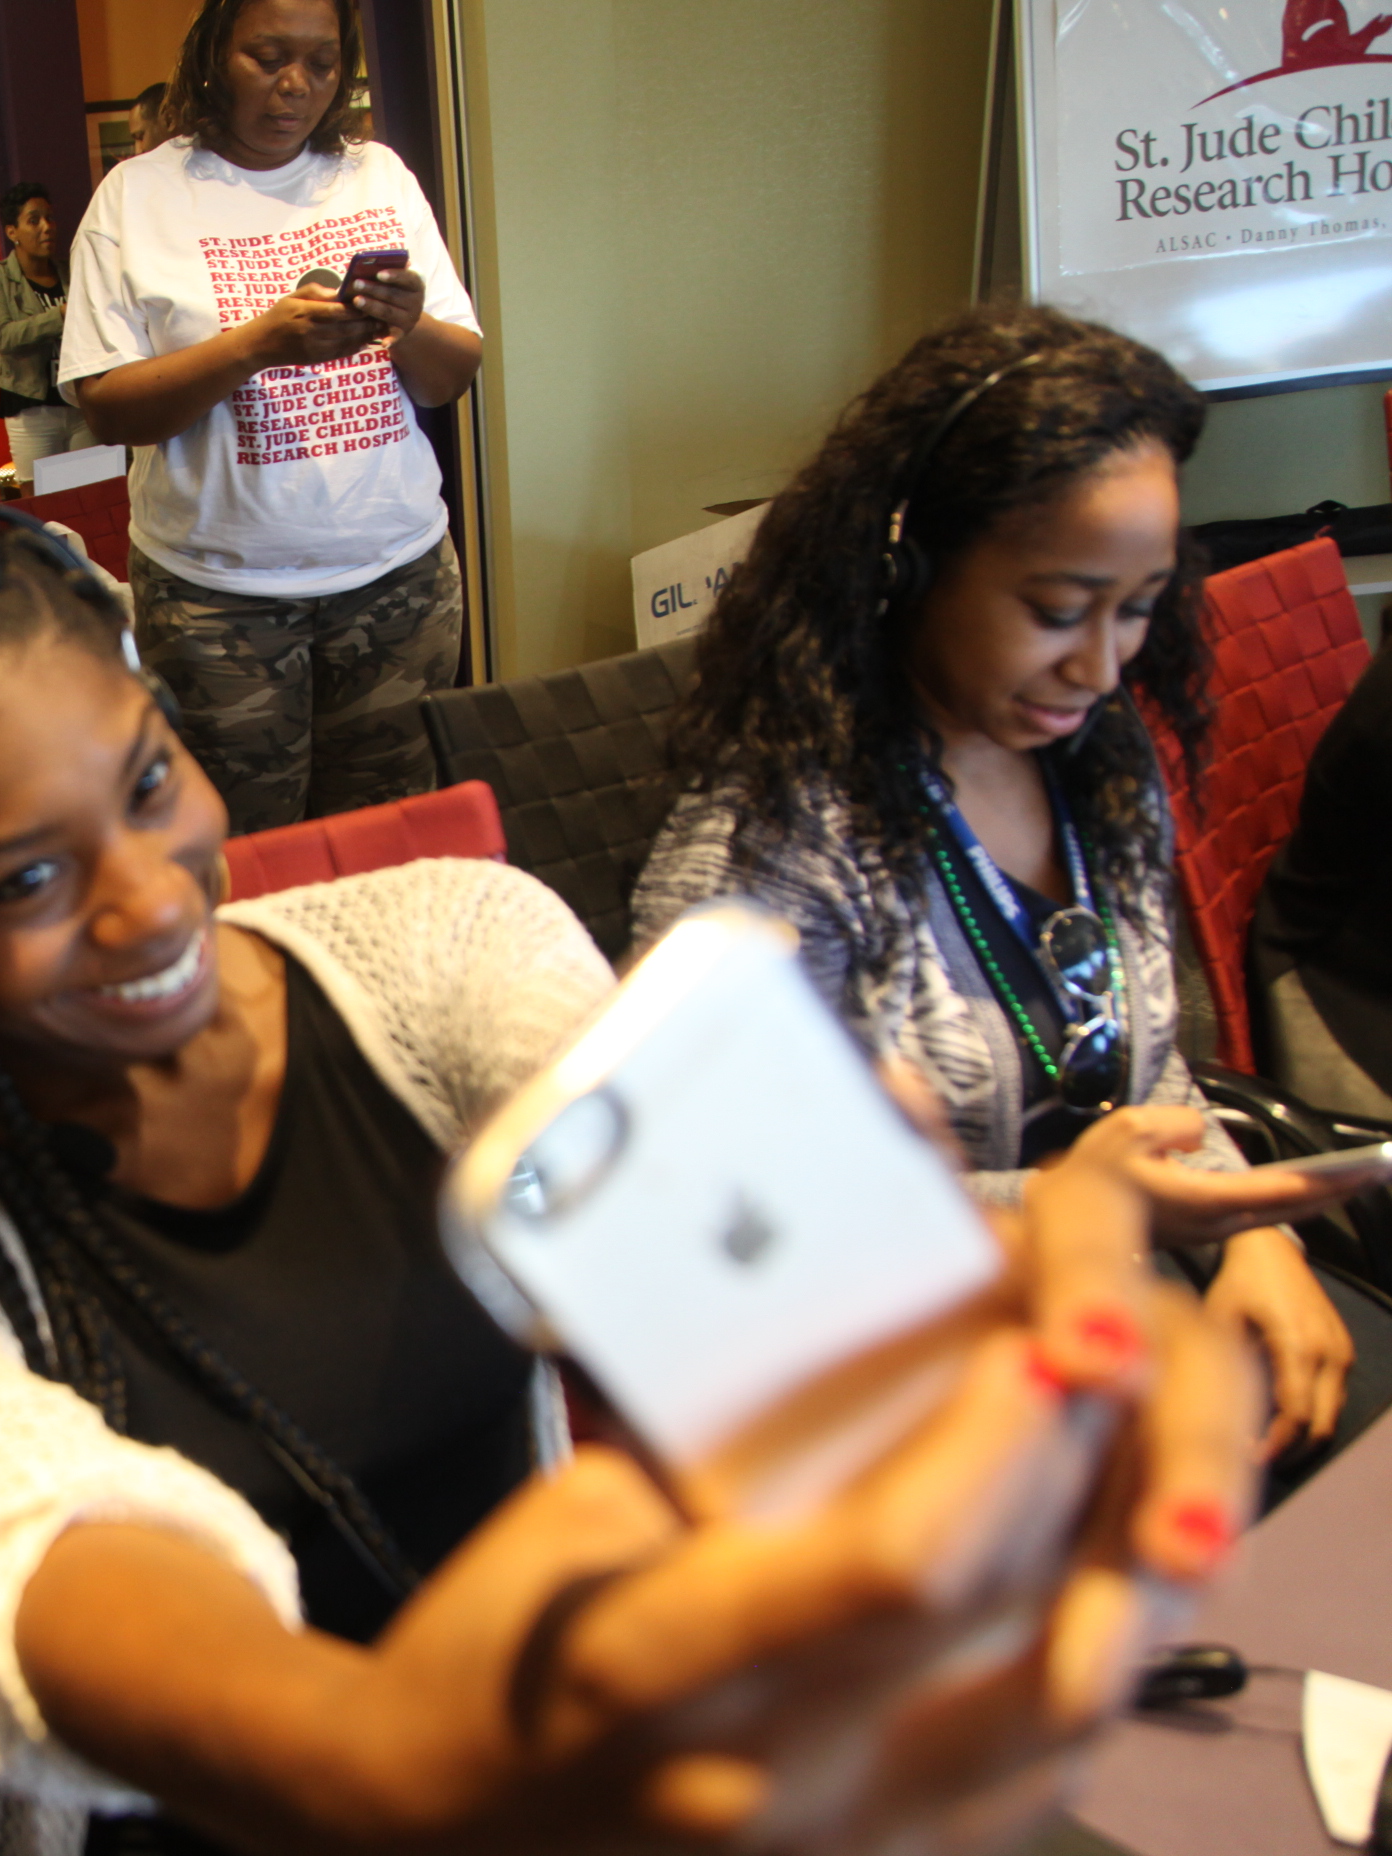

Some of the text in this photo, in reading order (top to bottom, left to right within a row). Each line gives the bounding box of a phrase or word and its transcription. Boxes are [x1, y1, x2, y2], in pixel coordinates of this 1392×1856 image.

[1114, 128, 1169, 172] St.
[1179, 115, 1282, 173] Jude
[1114, 150, 1392, 222] Research Ho
[199, 205, 397, 249] ST. JUDE CHILDREN'S
[203, 218, 403, 259] RESEARCH HOSPITAL
[207, 227, 406, 272] ST. JUDE CHILDREN'S
[1155, 232, 1218, 253] ALSAC
[1240, 227, 1298, 244] Danny
[213, 283, 291, 297] ST. JUDE
[219, 309, 249, 323] ST.
[260, 365, 306, 386] JUDE
[233, 377, 332, 402] RESEARCH
[234, 403, 259, 417] ST.
[262, 396, 307, 419] JUDE
[237, 410, 335, 433] RESEARCH
[237, 435, 261, 448] ST.
[264, 428, 310, 450] JUDE
[237, 442, 339, 465] RESEARCH
